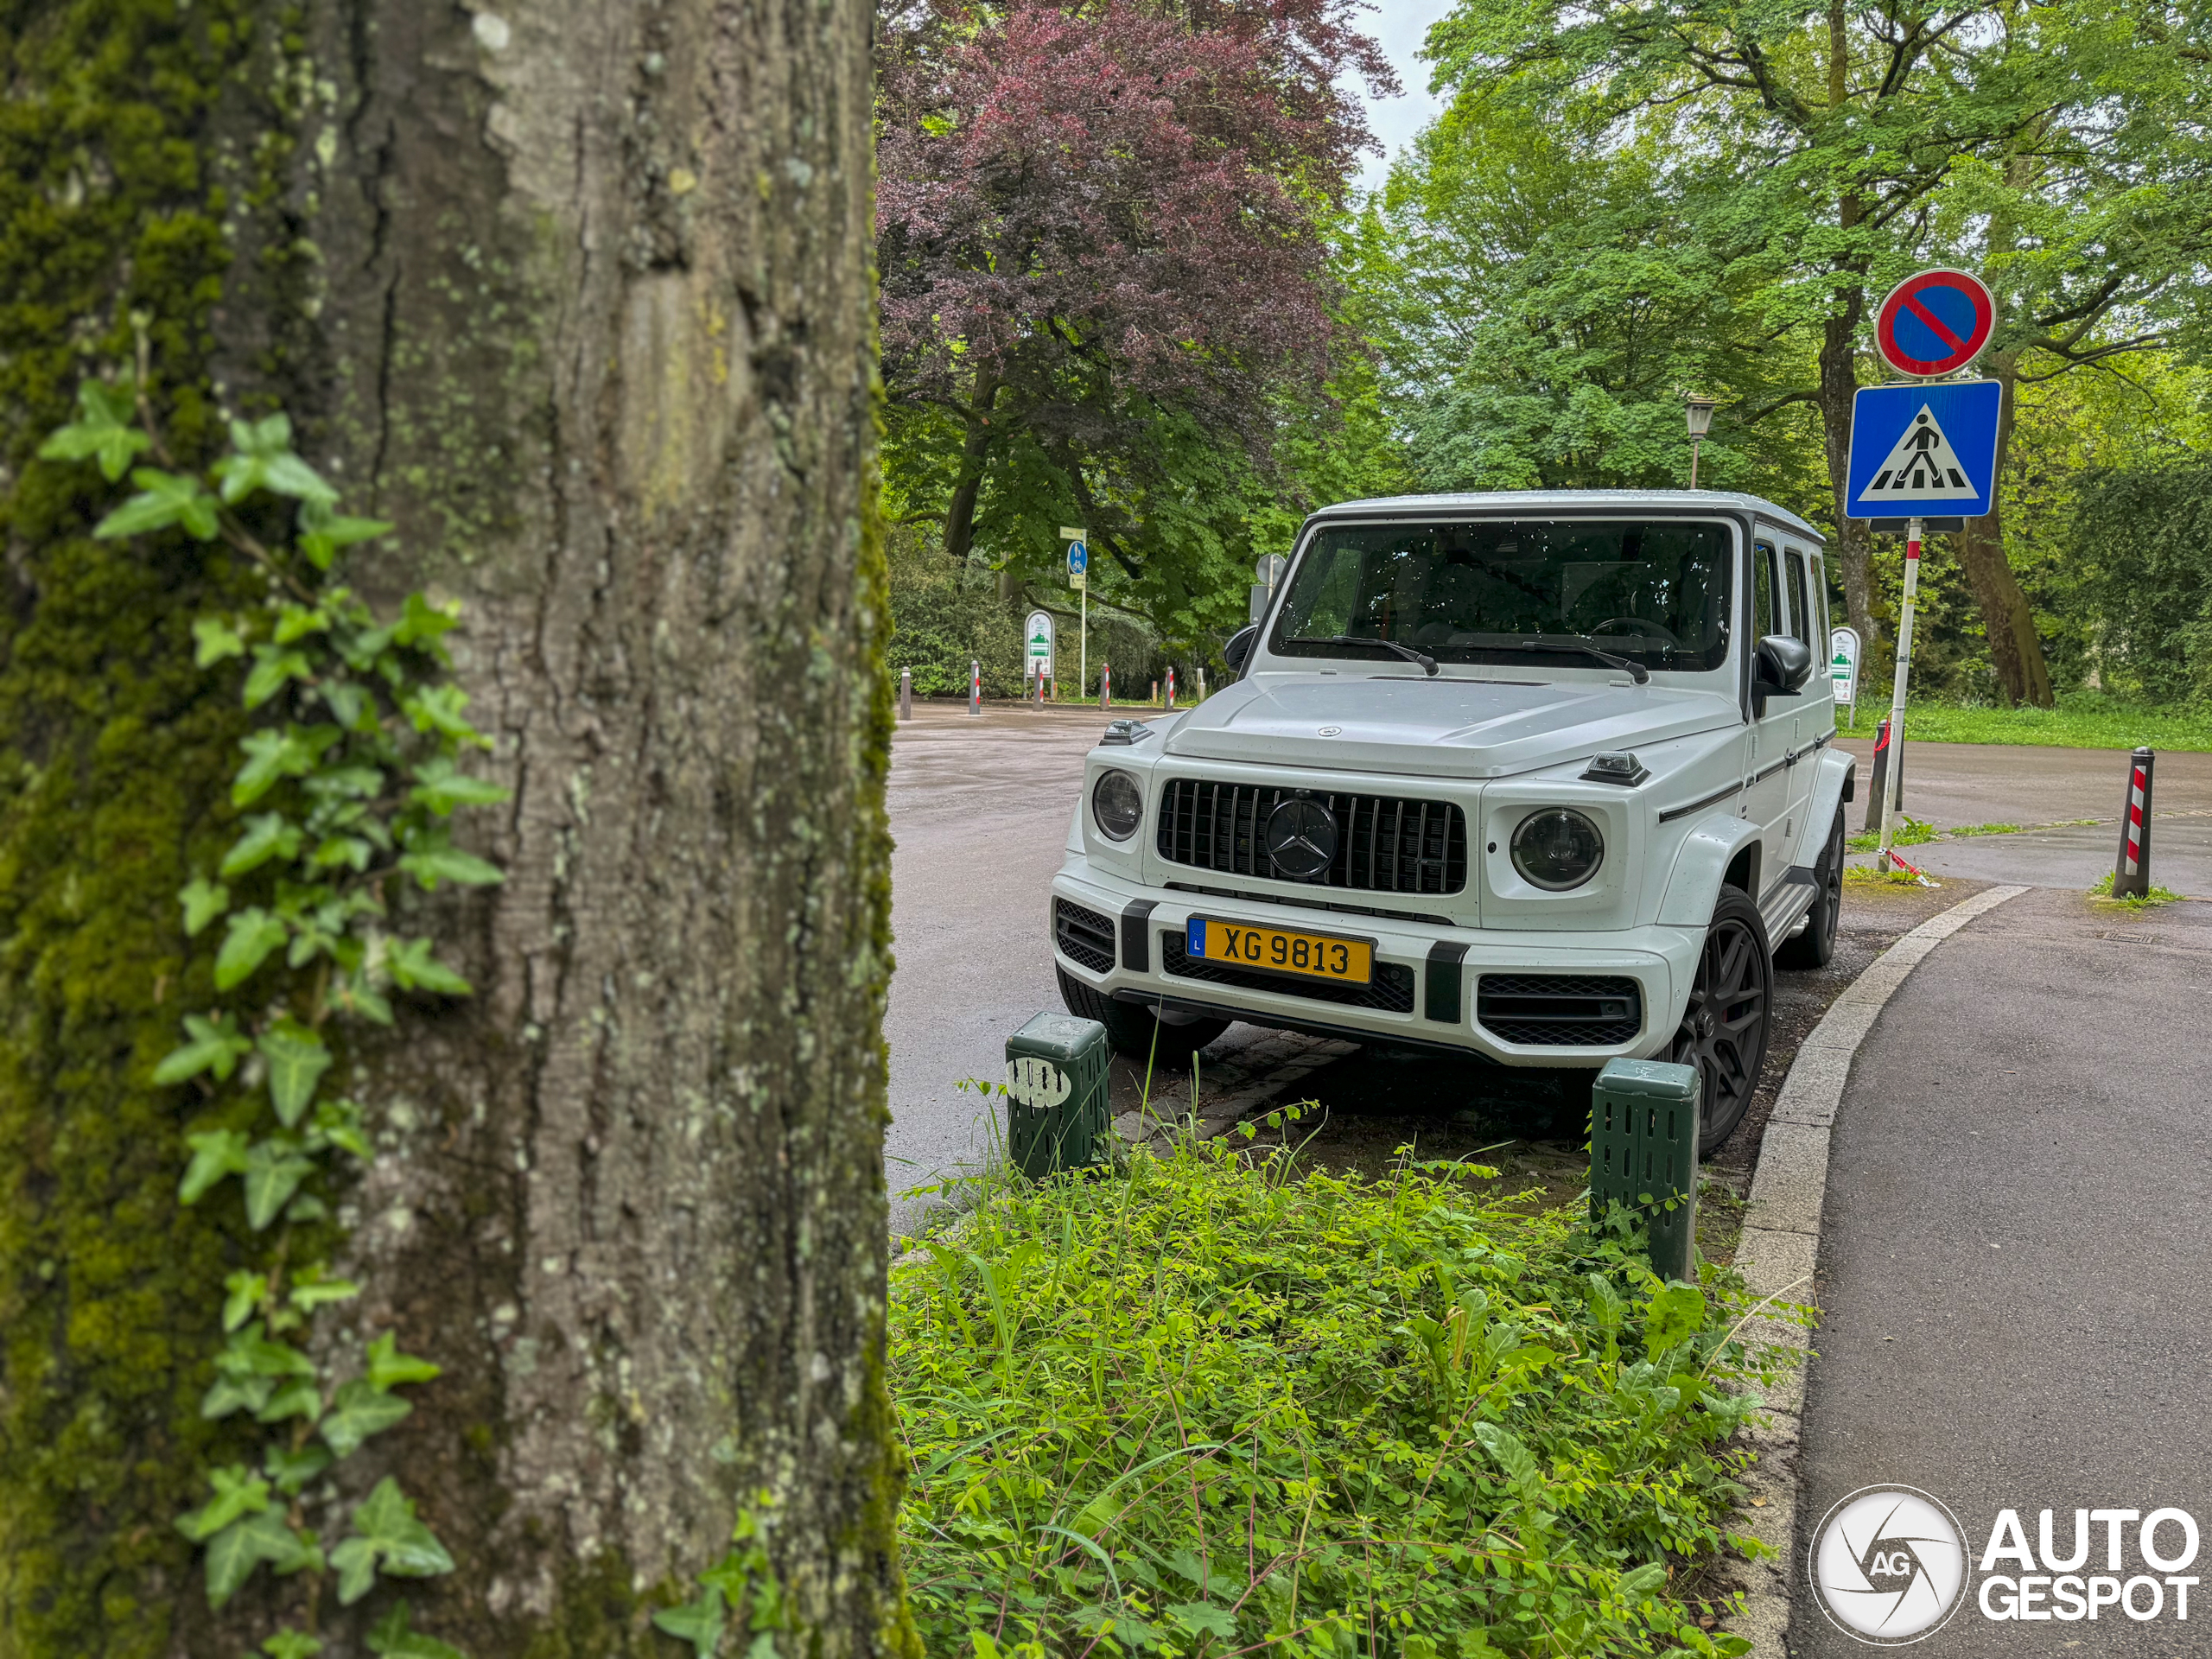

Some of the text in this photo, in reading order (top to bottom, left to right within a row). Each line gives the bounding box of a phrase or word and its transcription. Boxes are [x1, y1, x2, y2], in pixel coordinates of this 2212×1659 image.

[1194, 939, 1201, 950] L
[1224, 927, 1349, 974] XG 9813
